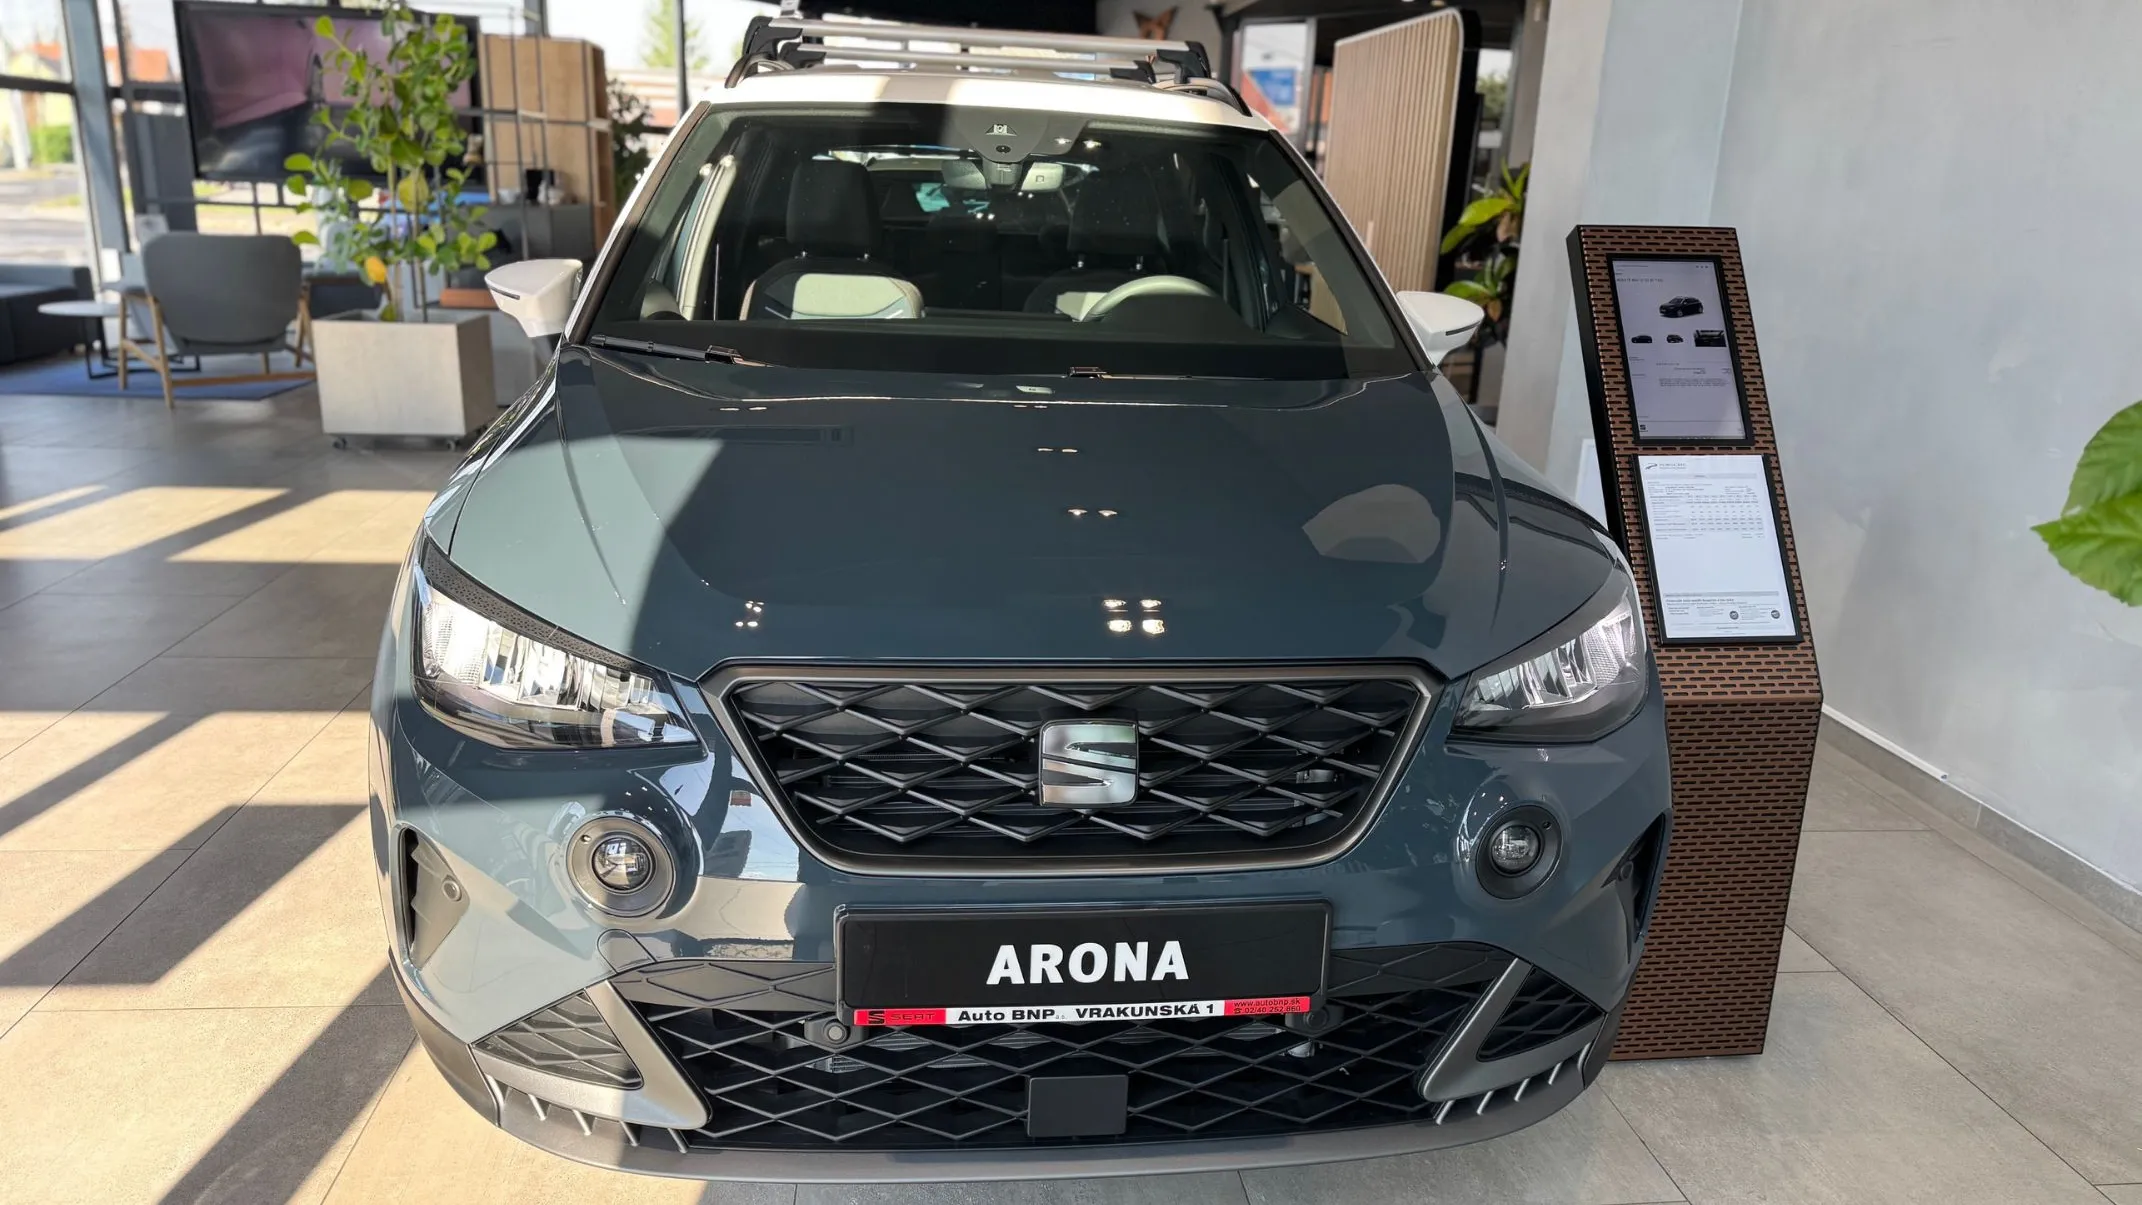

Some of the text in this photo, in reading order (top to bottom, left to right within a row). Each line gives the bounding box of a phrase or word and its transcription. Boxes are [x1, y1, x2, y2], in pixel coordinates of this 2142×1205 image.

[986, 941, 1189, 985] ARONA
[1233, 998, 1300, 1007] www.autobnp.sk
[958, 1010, 1005, 1021] Auto
[1012, 1009, 1055, 1020] BNP
[1076, 1003, 1199, 1019] VRAKUNSKÁ
[1206, 1004, 1214, 1014] 1
